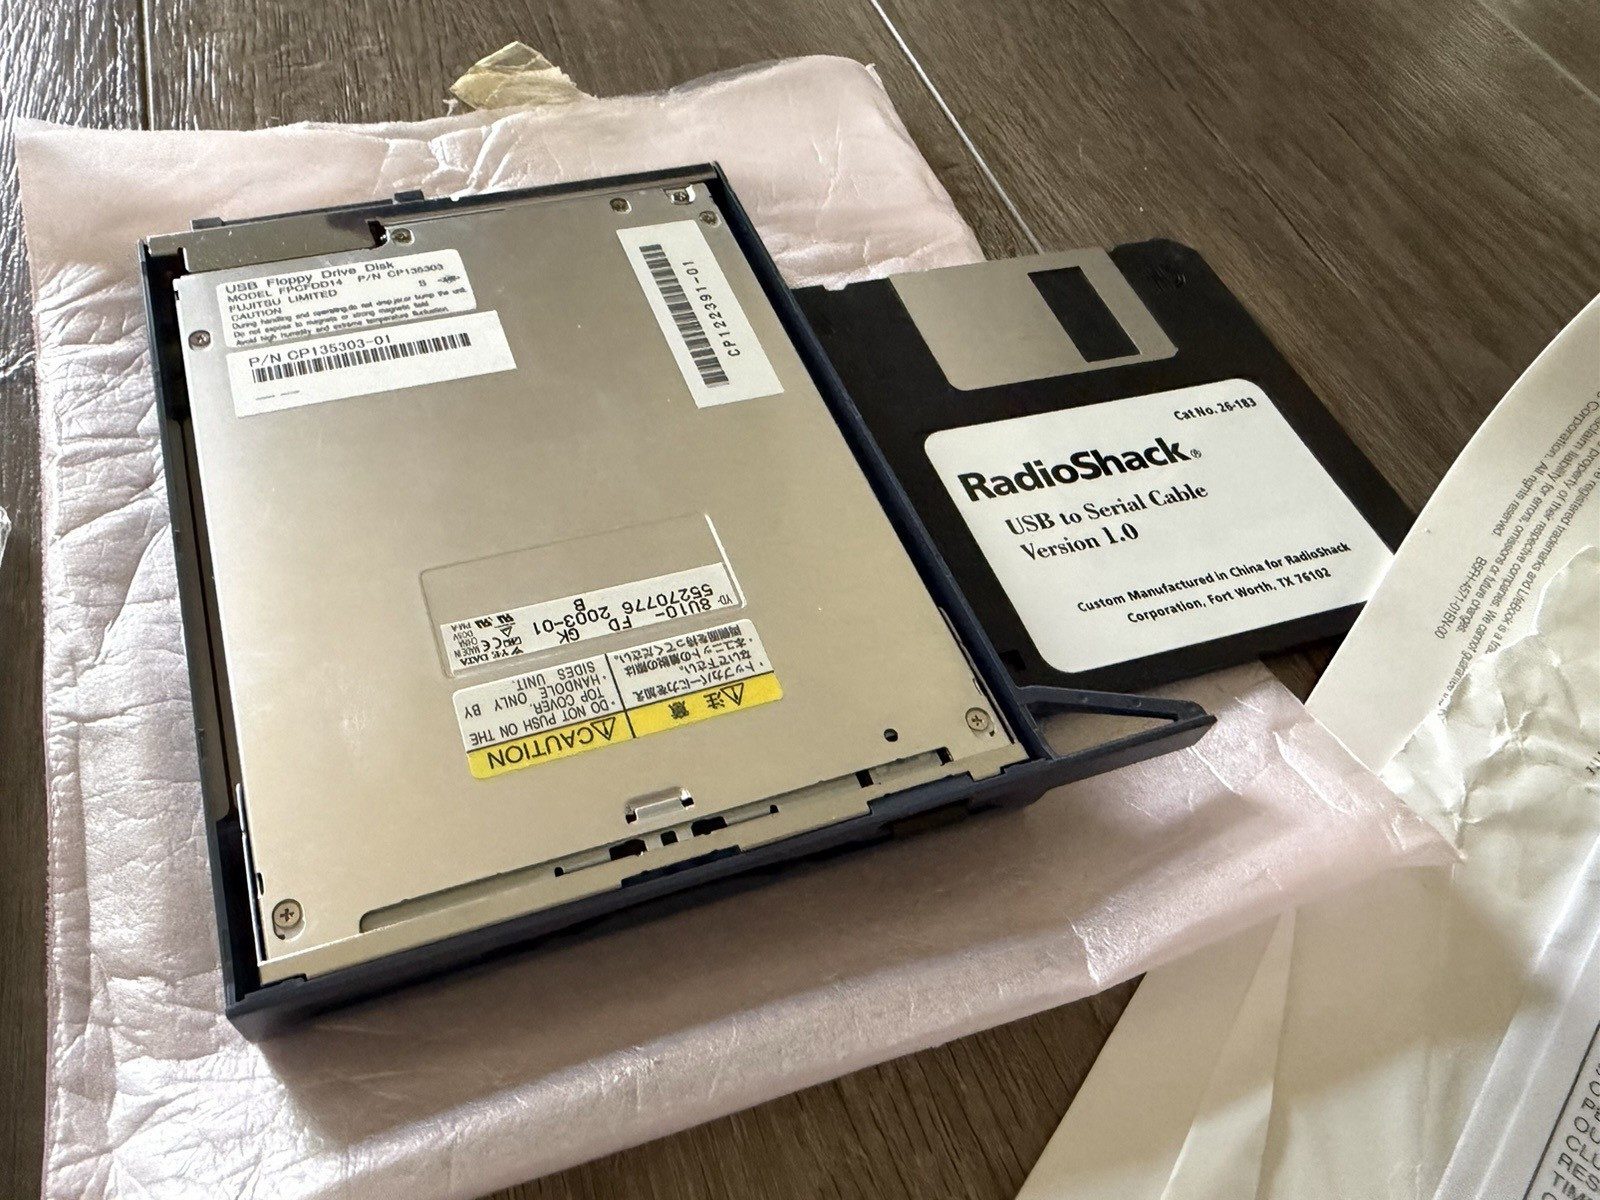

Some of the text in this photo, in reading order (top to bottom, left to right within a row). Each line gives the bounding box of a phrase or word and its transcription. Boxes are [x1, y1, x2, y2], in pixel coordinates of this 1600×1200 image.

[225, 261, 394, 294] USB Floppy Drive Disk
[227, 290, 273, 303] MODEL
[357, 272, 381, 283] P/N
[228, 289, 338, 313] FUJITSU LIMITED
[231, 307, 282, 322] CAUTION
[232, 321, 257, 330] During
[260, 315, 292, 325] handling
[295, 311, 310, 320] and
[437, 289, 450, 297] the
[682, 261, 741, 357] CP122391-01
[233, 331, 246, 339] Do
[248, 328, 261, 336] not
[236, 337, 258, 346] Avoid
[260, 333, 277, 343] high
[315, 324, 330, 333] and
[249, 334, 392, 368] P/N CP135303-01
[1173, 397, 1258, 422] Cat No. 26-183
[1547, 400, 1600, 459] Corporation.
[1534, 460, 1549, 477] All
[1547, 450, 1579, 483] liability
[1563, 448, 1600, 495] property
[1515, 474, 1538, 501] rights
[1541, 482, 1555, 498] for
[1557, 489, 1569, 503] of
[1560, 478, 1597, 526] registered
[1004, 483, 1209, 536] USB to Serial Cable
[1491, 500, 1521, 537] reserved.
[1518, 496, 1543, 524] errors,
[1543, 500, 1563, 522] their
[1020, 522, 1140, 562] Version 1.0
[1495, 523, 1524, 566] omissions
[1516, 520, 1548, 564] respective
[1531, 523, 1566, 572] trademarks
[1077, 541, 1353, 613] Custom Manufactured in China for RadioShack
[1489, 565, 1501, 576] or
[1489, 561, 1522, 608] companies.
[1521, 571, 1537, 590] and
[1127, 567, 1332, 624] Corporation, Fort Worth, TX 76102
[1478, 575, 1497, 600] future
[532, 583, 714, 636] 55270776 2003-01
[573, 598, 587, 612] B
[1456, 598, 1482, 633] changes.
[1481, 608, 1498, 625] We
[1503, 587, 1530, 626] LifeBook
[556, 598, 712, 645] 8U10- FD GK
[1494, 633, 1503, 641] a
[1497, 625, 1507, 633] is
[453, 645, 481, 659] MADE IN
[458, 636, 479, 649] CHINA
[1467, 623, 1488, 654] cannot
[459, 653, 489, 667] DATA
[678, 649, 751, 675] ないで下さい。
[511, 660, 596, 692] SIDES UNIT.
[464, 673, 601, 720] HANDOLE ONLY BY
[529, 686, 606, 716] TOP COVER.
[469, 698, 610, 747] DO NOT PUSH ON THE
[486, 726, 595, 770] CAUTION
